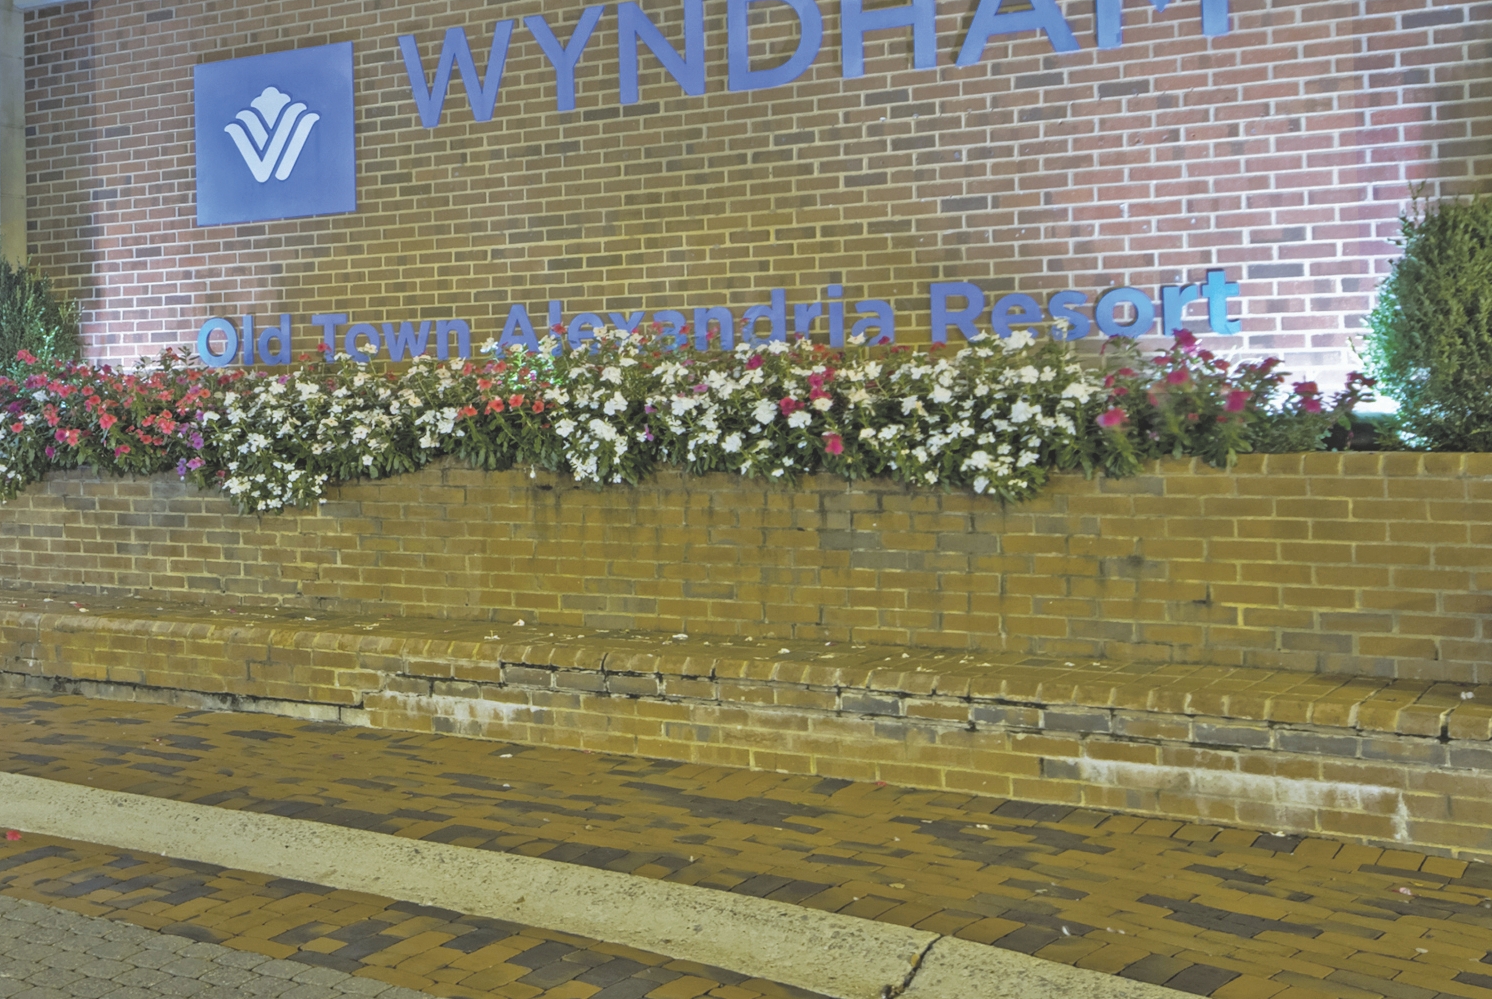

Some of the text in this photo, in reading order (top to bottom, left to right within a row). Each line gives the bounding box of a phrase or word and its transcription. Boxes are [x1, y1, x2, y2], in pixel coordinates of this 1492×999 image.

[197, 313, 292, 367] Old
[311, 312, 472, 364] Town
[930, 268, 1242, 343] Resort
